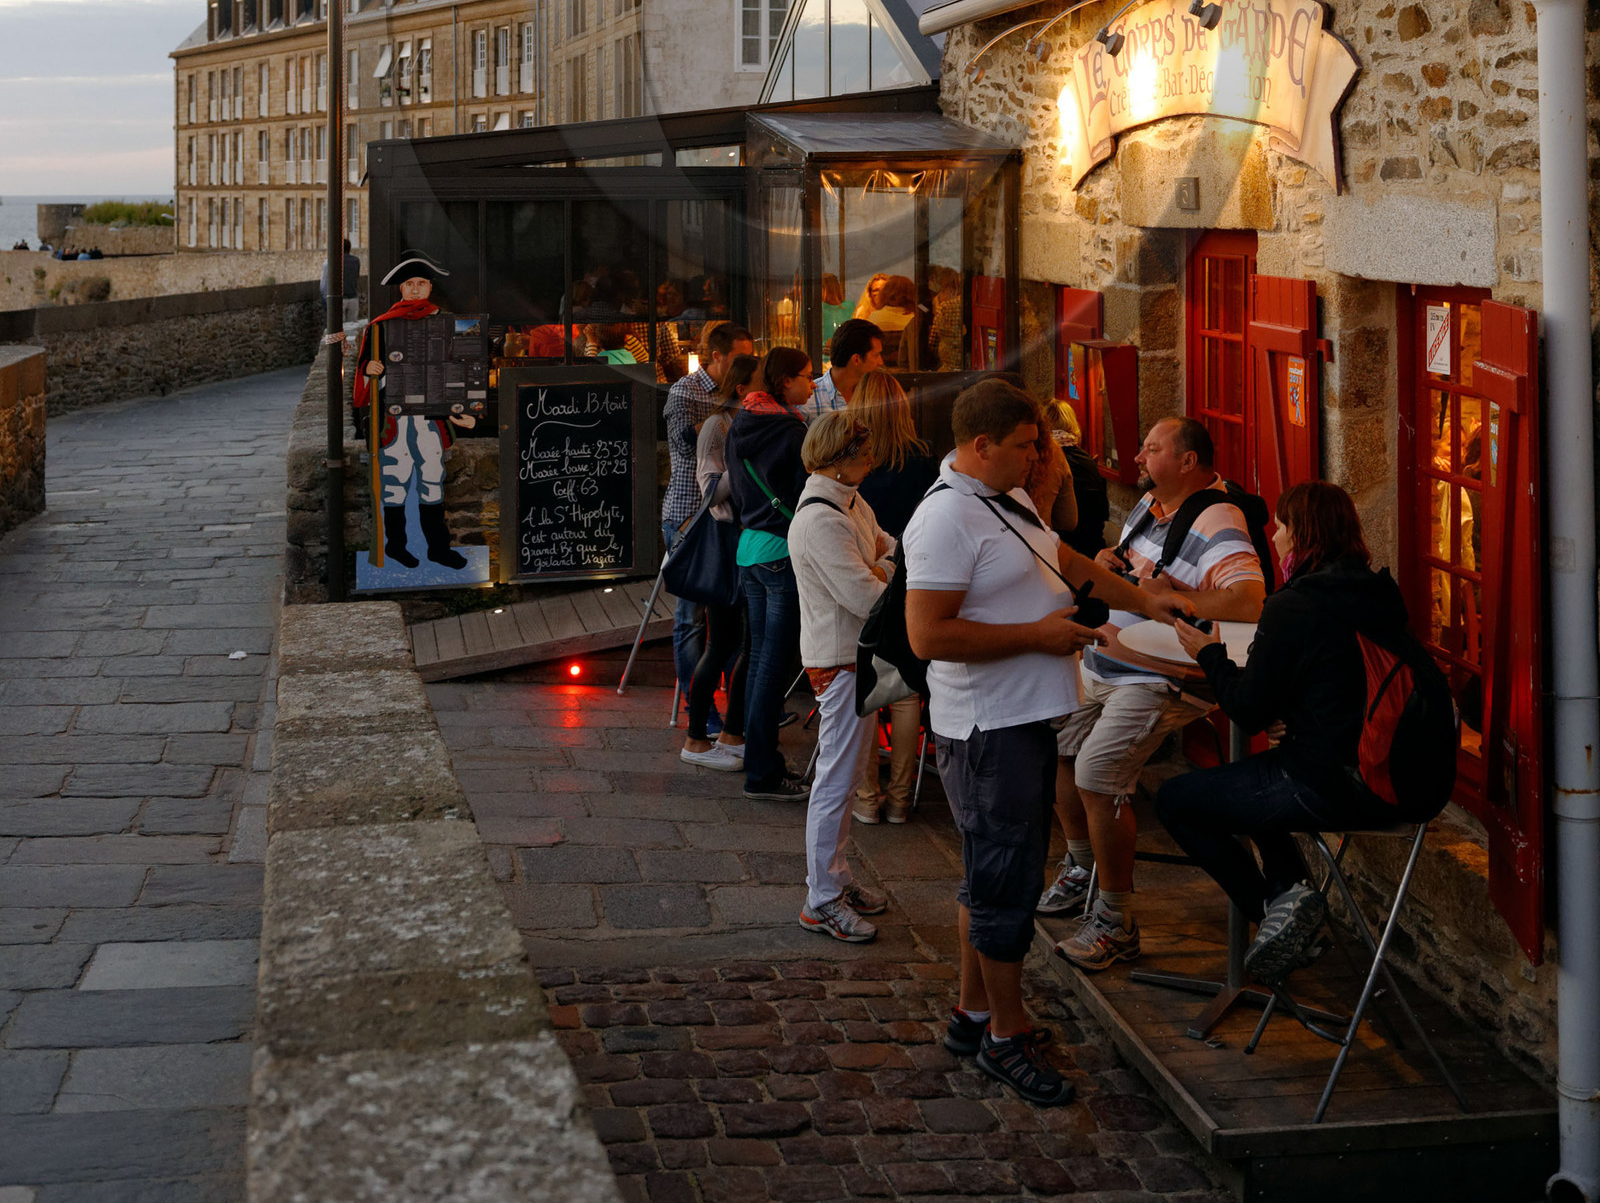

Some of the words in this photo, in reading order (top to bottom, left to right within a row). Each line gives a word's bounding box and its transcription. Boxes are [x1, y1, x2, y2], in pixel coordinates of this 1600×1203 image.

[526, 388, 580, 419] Mardi
[583, 392, 600, 413] 13
[599, 391, 628, 414] Août
[521, 437, 561, 461] Marée
[519, 460, 559, 480] Marée
[580, 477, 599, 496] 63
[538, 507, 554, 526] la
[550, 527, 587, 540] autour
[594, 522, 614, 537] du
[576, 543, 597, 561] que
[600, 536, 619, 552] le
[533, 554, 577, 573] goëland
